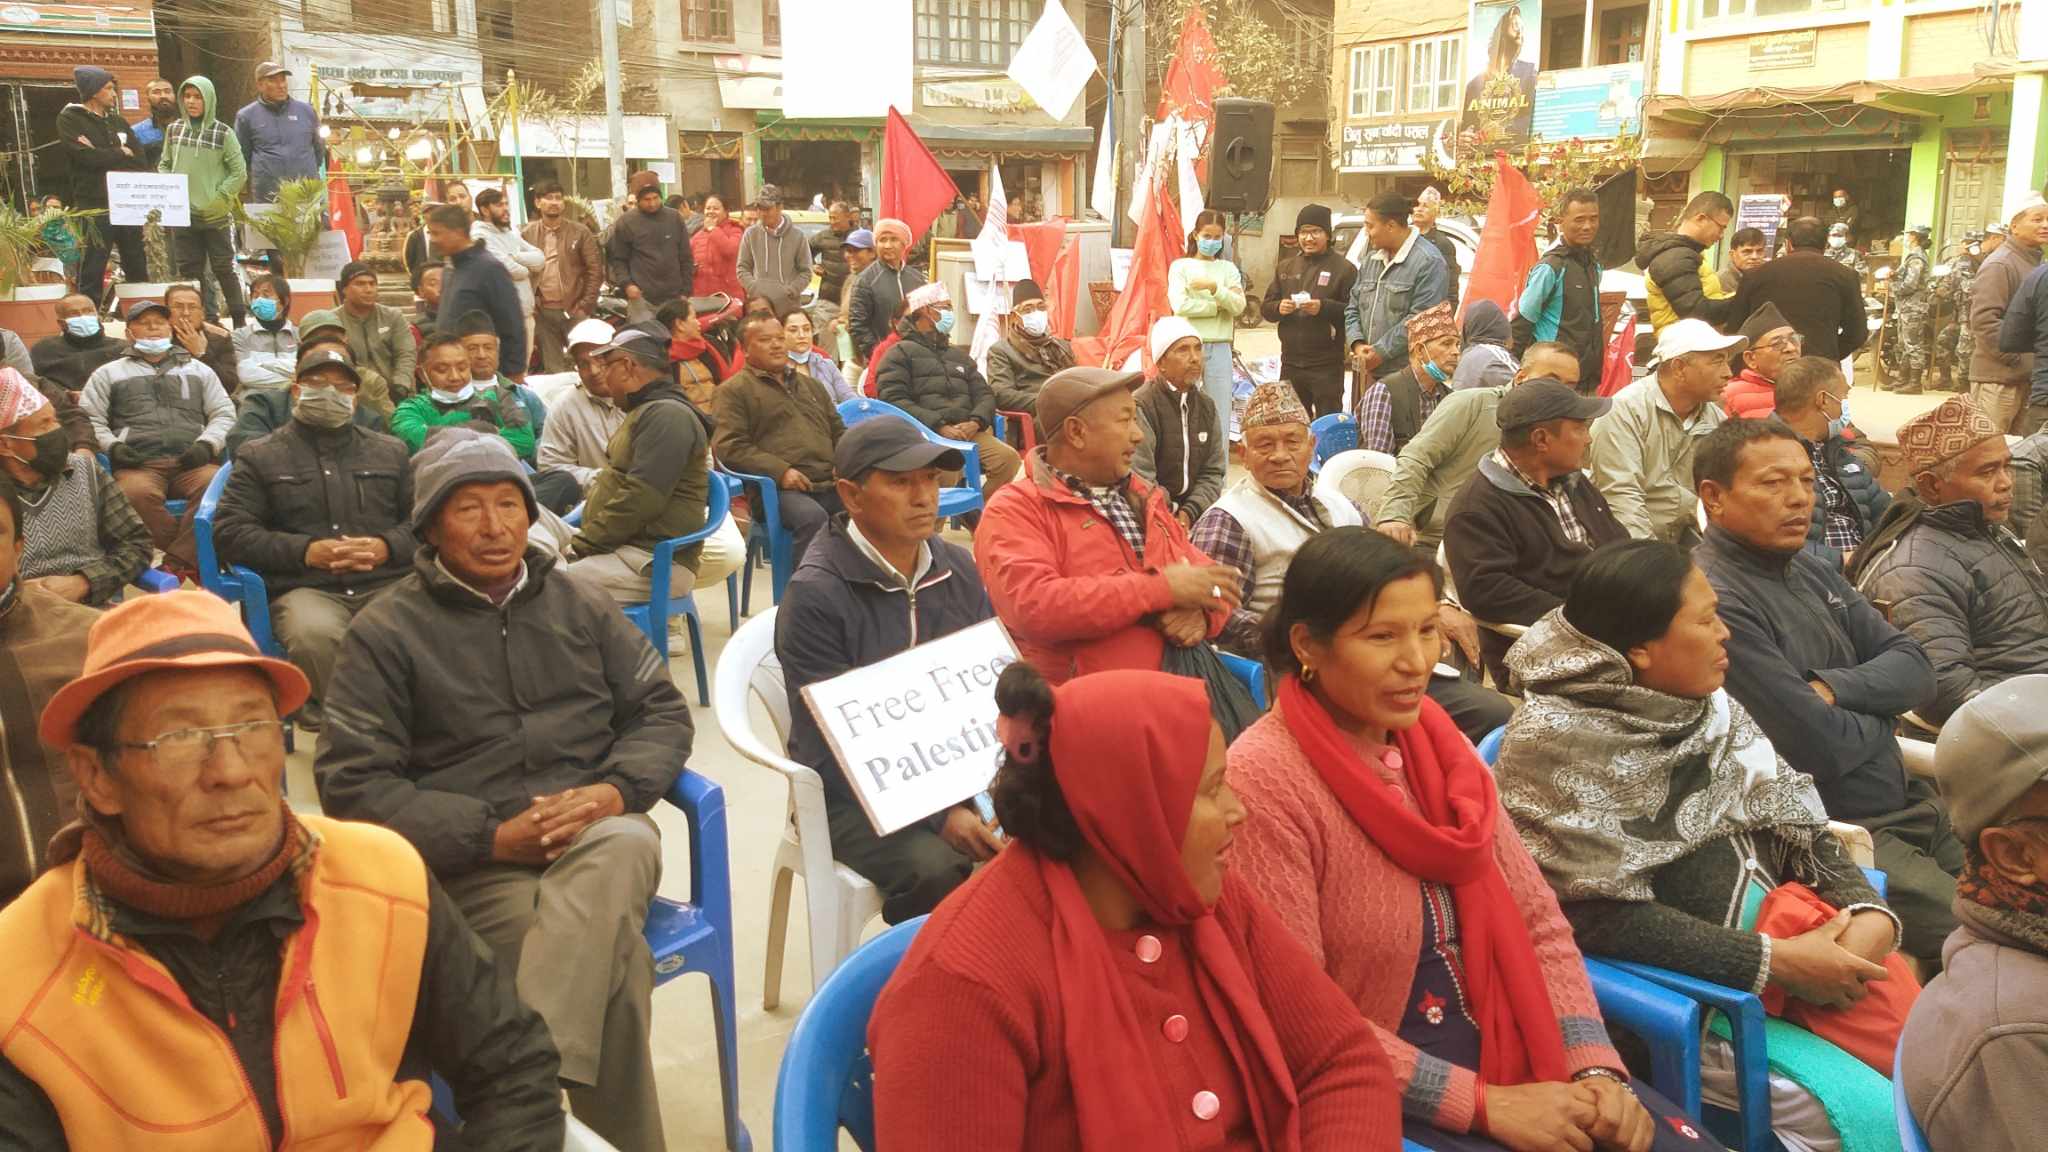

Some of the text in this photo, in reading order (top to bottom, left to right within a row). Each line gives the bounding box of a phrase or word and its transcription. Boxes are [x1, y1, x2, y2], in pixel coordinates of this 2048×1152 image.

[1467, 95, 1529, 111] ANIMAL
[836, 655, 1017, 738] Free Free
